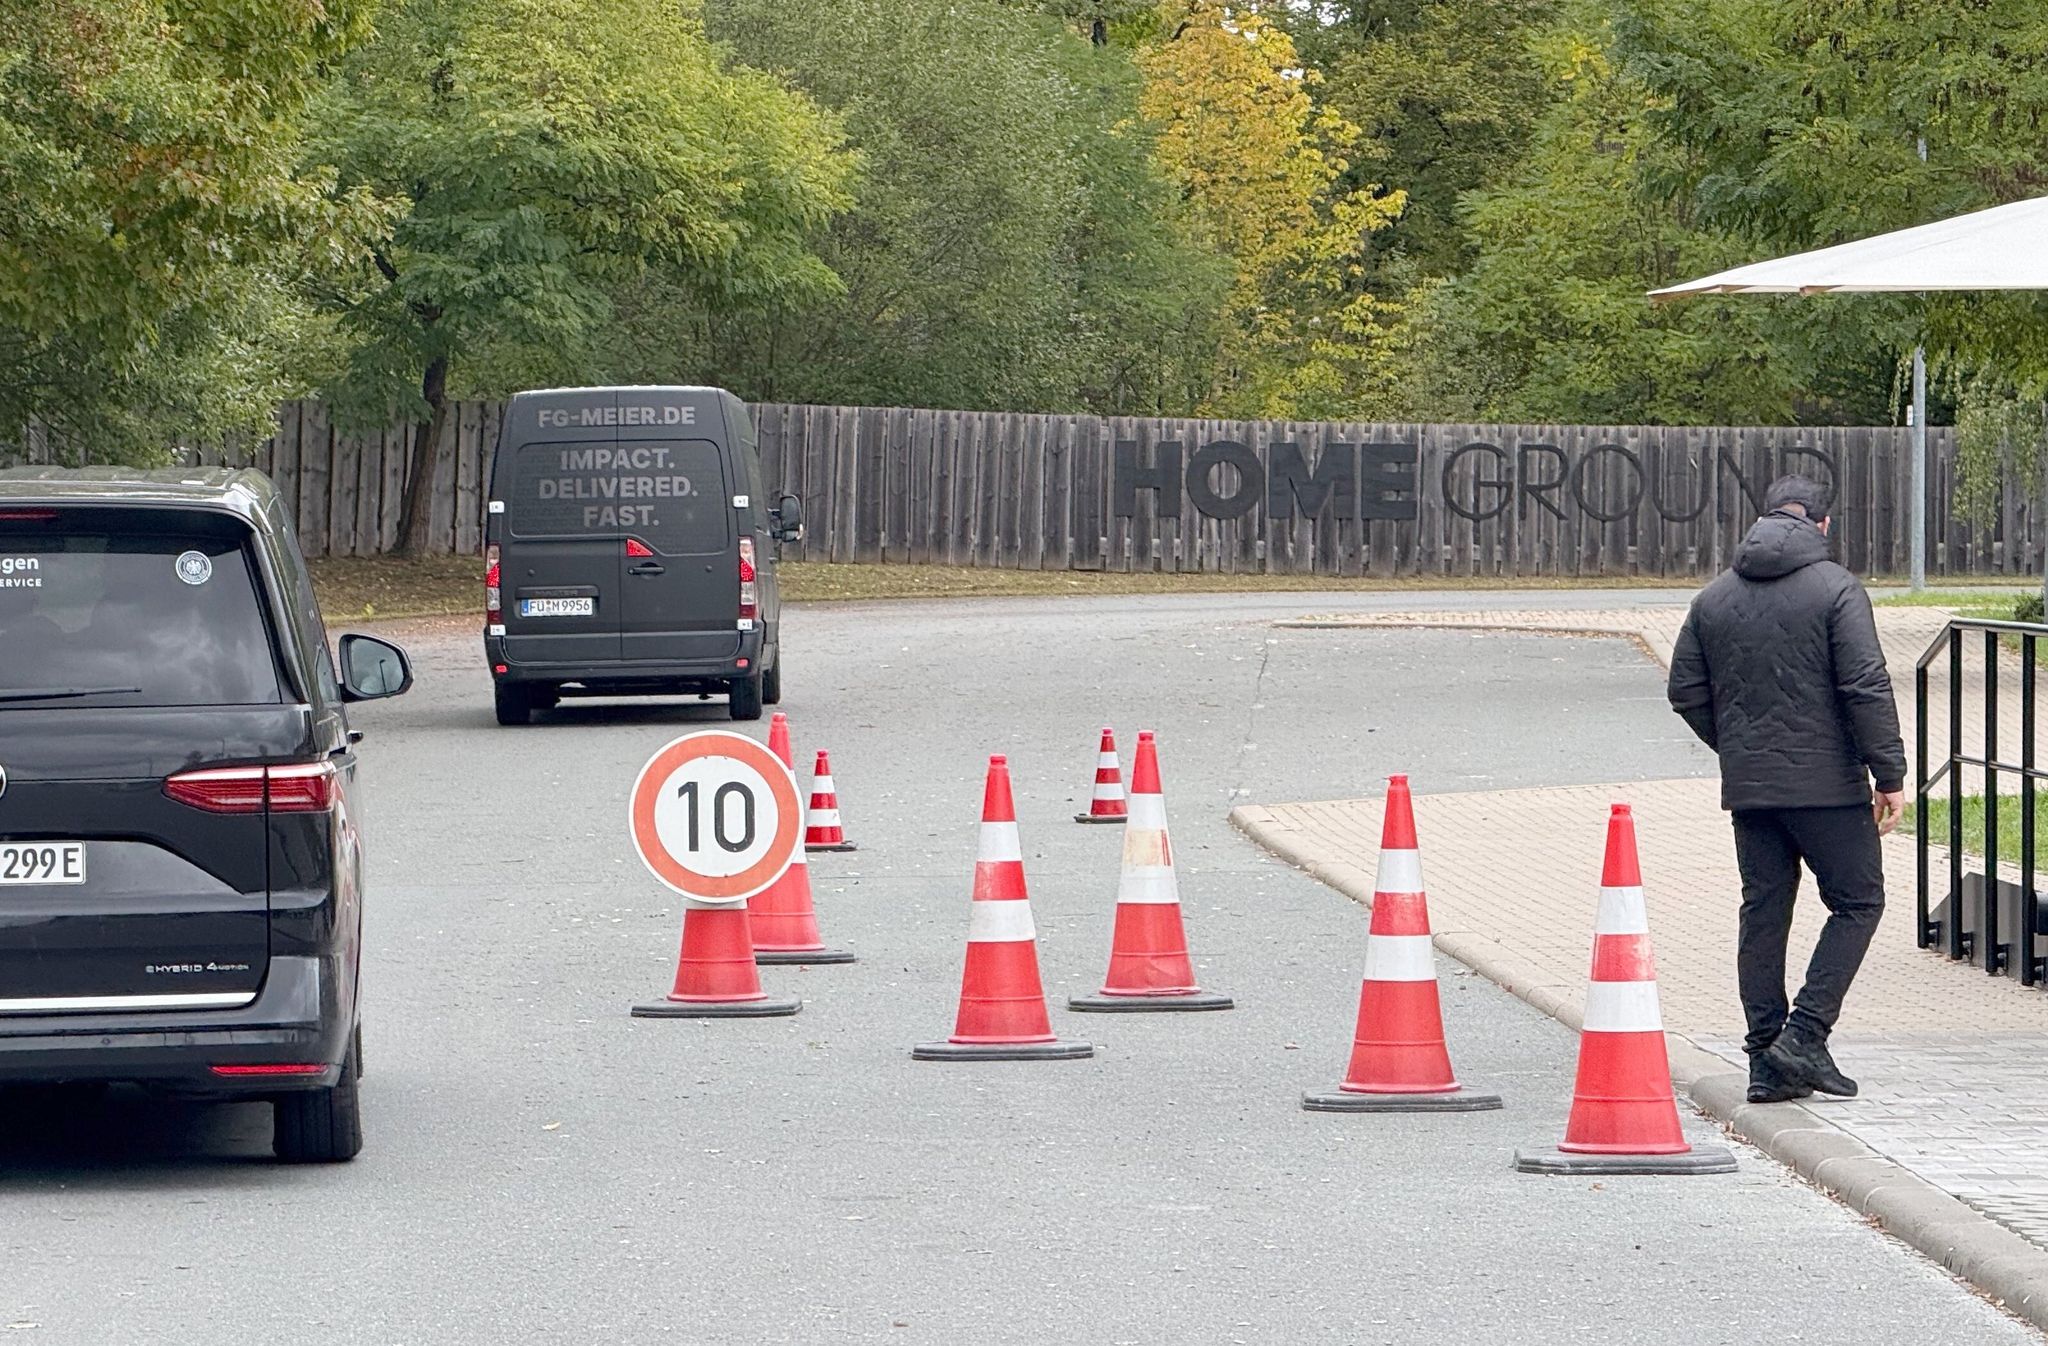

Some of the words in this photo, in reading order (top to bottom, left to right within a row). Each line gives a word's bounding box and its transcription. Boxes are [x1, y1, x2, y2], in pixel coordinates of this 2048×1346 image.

[538, 406, 696, 428] FG-MEIER.DE
[561, 448, 675, 471] IMPACT.
[539, 476, 698, 499] DELIVERED.
[1114, 441, 1417, 520] HOME
[1441, 443, 1839, 522] GROUND
[583, 505, 659, 527] FAST.
[0, 557, 39, 575] gen
[678, 781, 756, 853] 10
